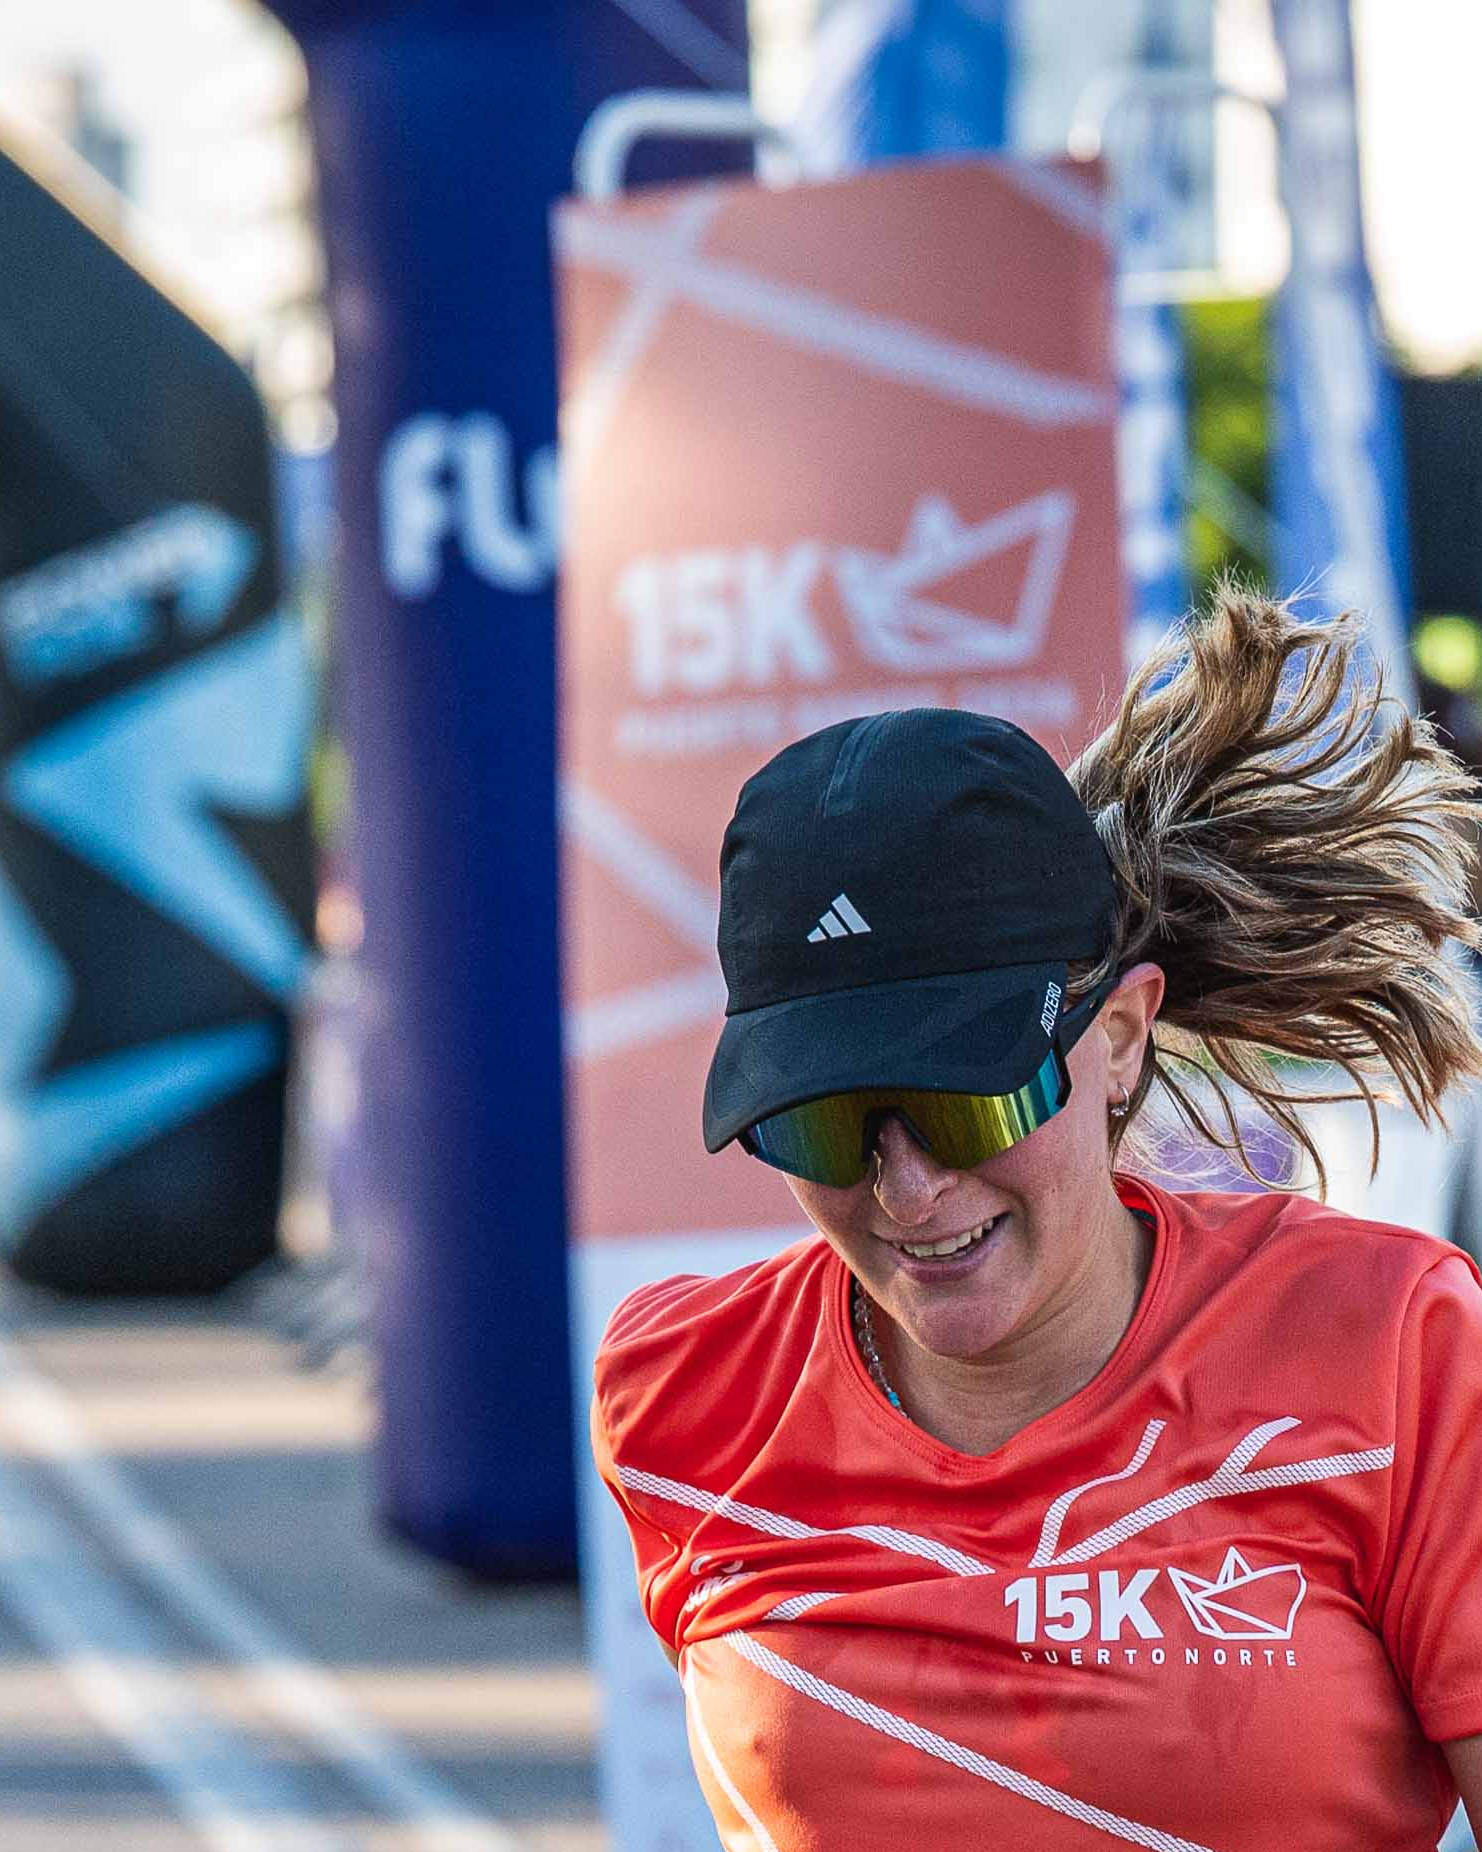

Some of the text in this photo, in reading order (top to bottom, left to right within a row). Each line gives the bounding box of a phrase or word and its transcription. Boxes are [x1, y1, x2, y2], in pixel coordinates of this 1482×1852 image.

[620, 545, 831, 692] 15K
[1040, 981, 1062, 1038] ADIZERO
[1004, 1569, 1165, 1643] 15K
[1021, 1648, 1298, 1667] PUERTO NORTE
